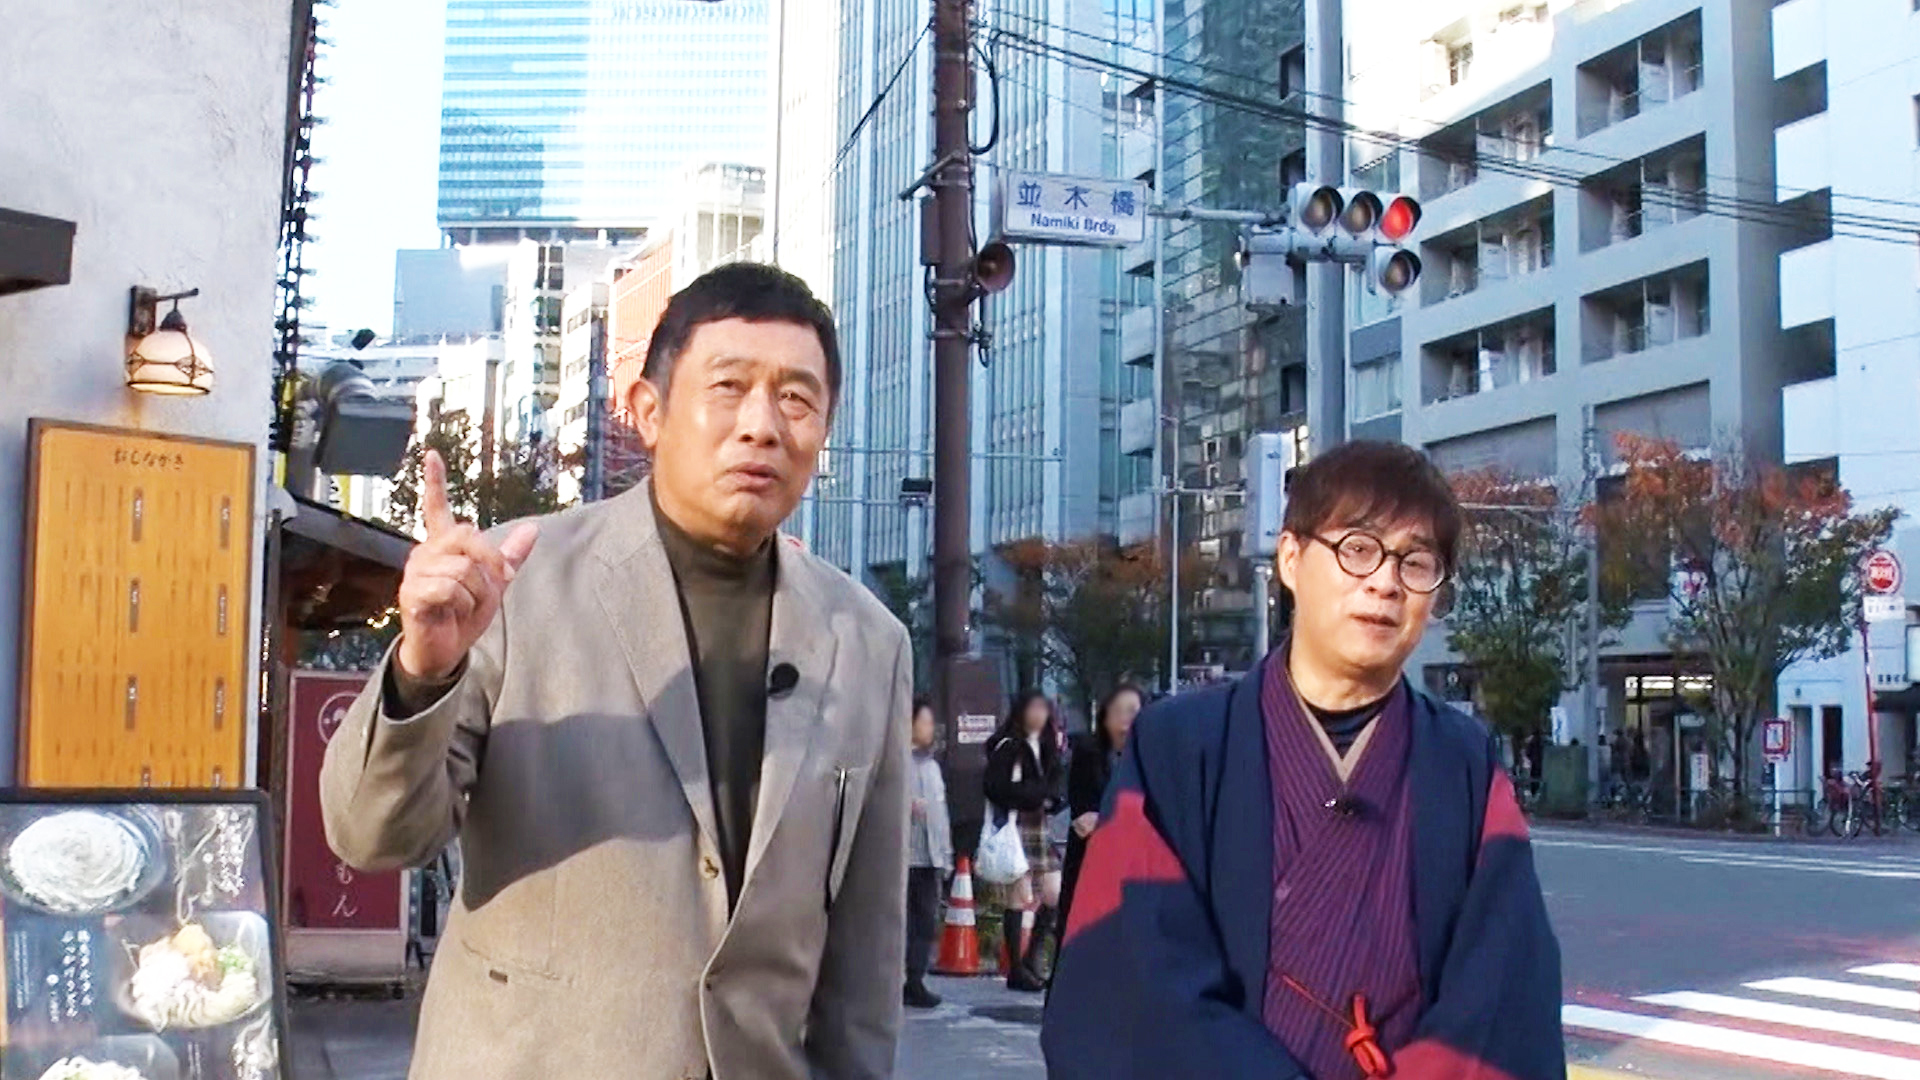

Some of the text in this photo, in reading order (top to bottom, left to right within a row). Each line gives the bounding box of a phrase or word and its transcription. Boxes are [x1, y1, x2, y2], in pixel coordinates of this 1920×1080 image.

[1016, 180, 1136, 217] 並木橋
[1031, 213, 1080, 231] Namiki
